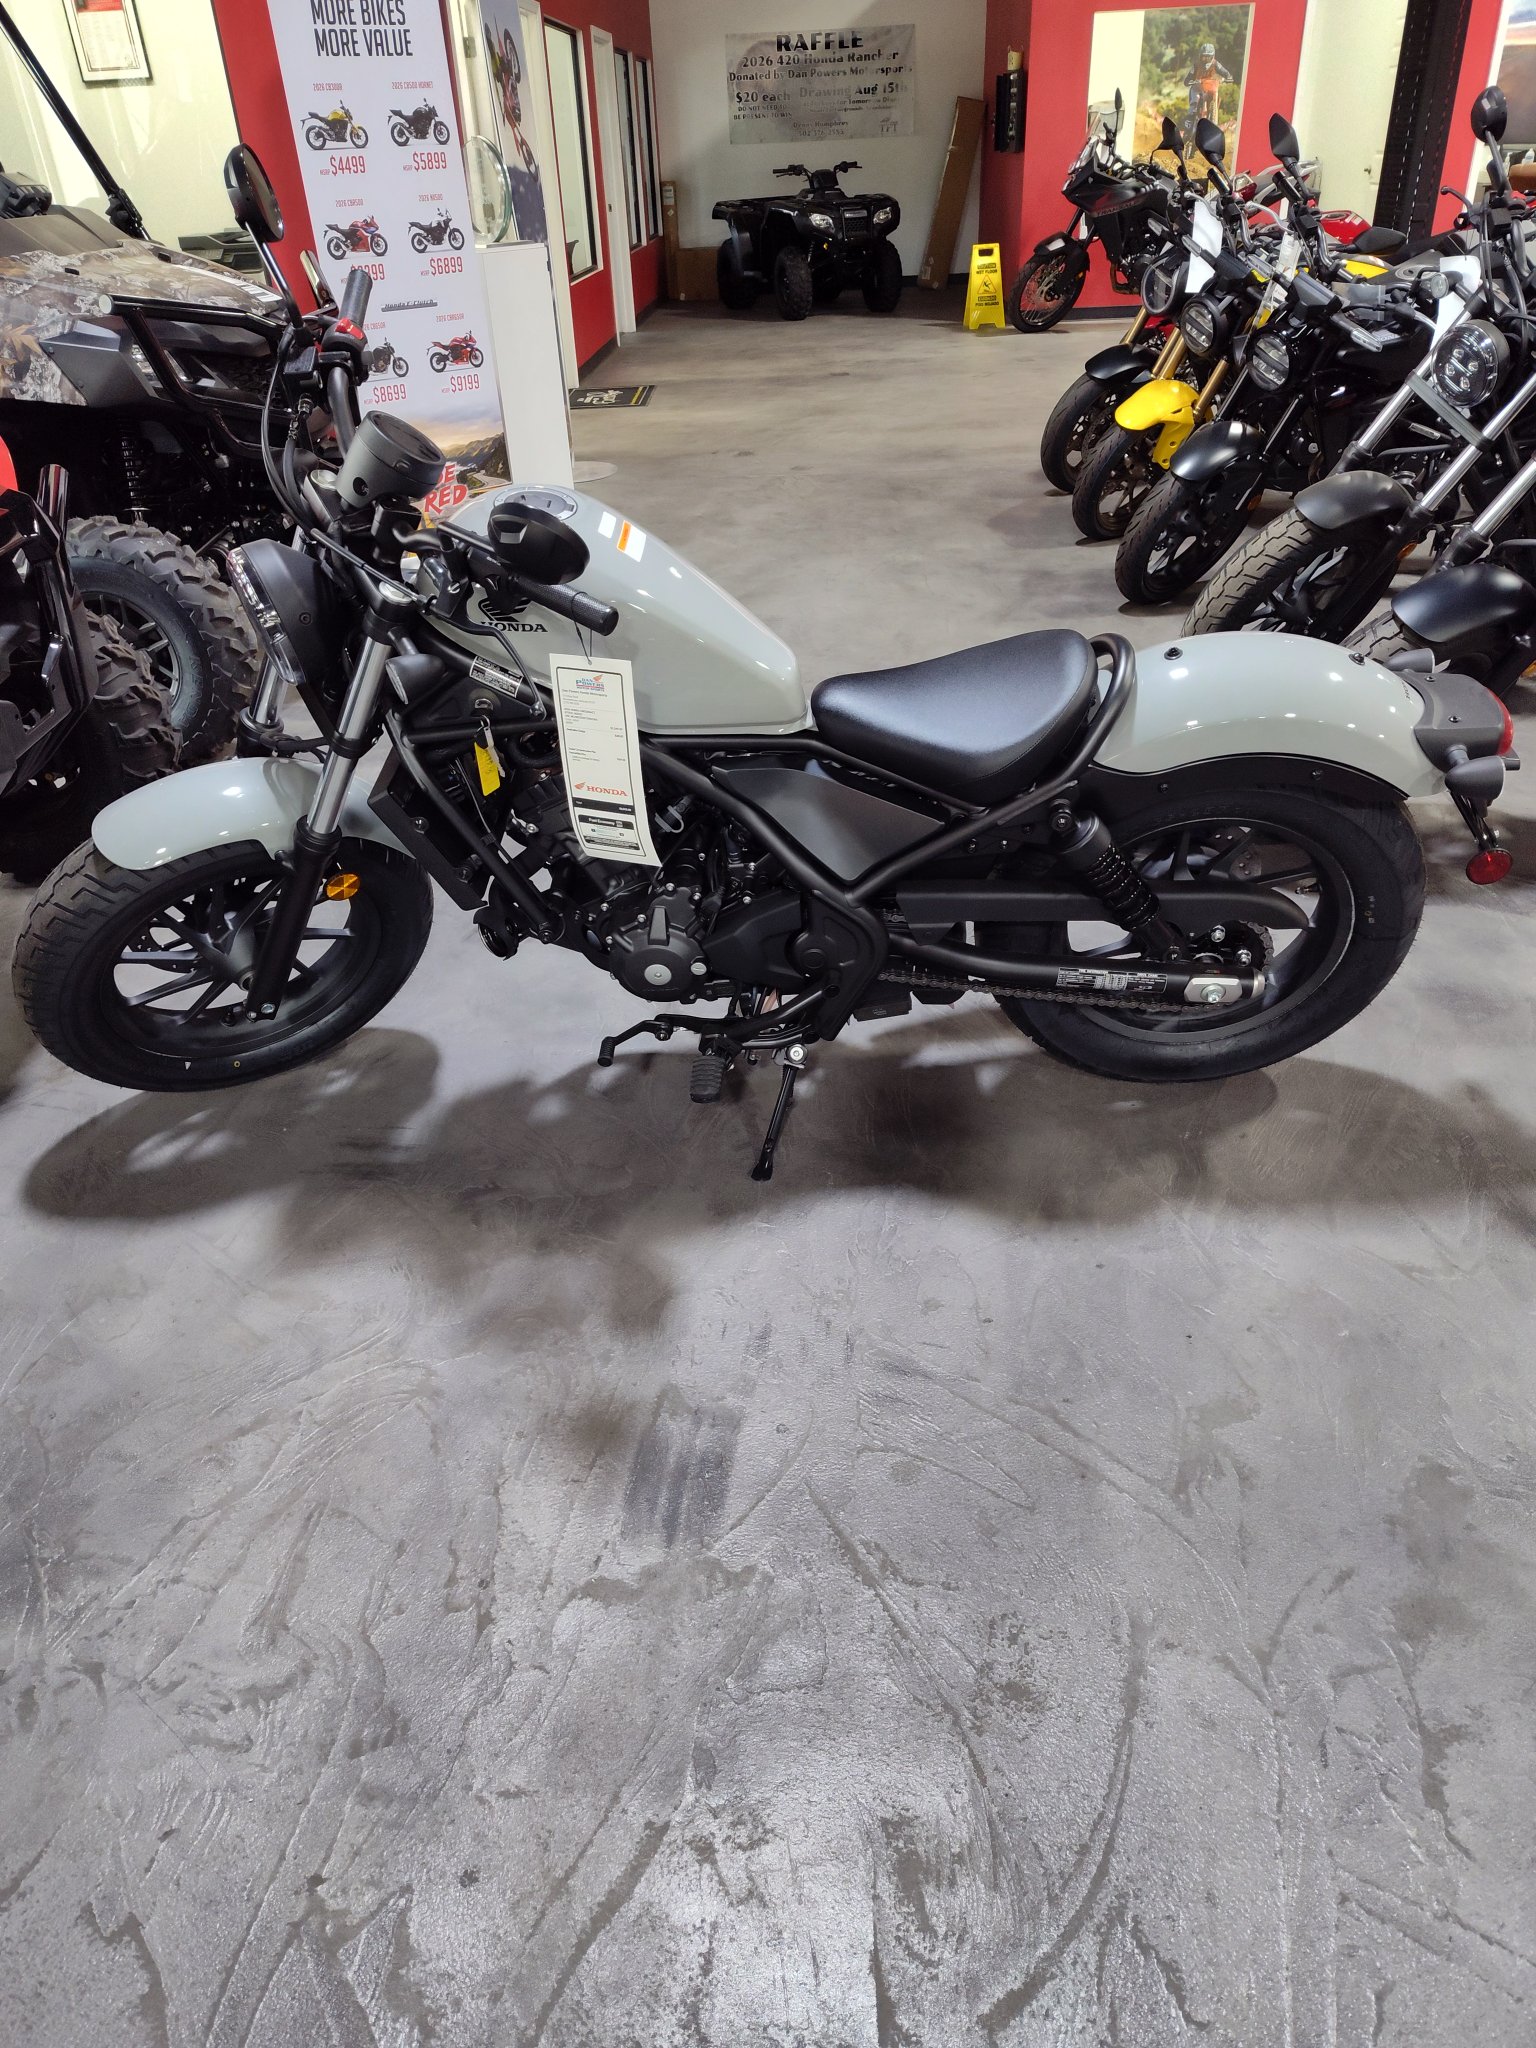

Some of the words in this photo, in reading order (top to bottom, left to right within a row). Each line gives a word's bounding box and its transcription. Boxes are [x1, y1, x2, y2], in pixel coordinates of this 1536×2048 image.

[310, 0, 356, 25] MORE
[360, 0, 406, 25] BIKES
[314, 28, 360, 57] MORE
[362, 28, 413, 57] VALUE
[776, 31, 864, 52] RAFFLE
[742, 56, 773, 68] 2026
[777, 54, 800, 66] 420
[804, 52, 844, 65] Honda
[729, 71, 771, 82] Donated
[773, 71, 785, 81] by
[788, 69, 808, 79] Dan
[810, 67, 847, 78] Powers
[313, 83, 325, 92] 2026
[392, 81, 403, 90] 2026
[736, 91, 759, 105] $20
[762, 91, 790, 102] each
[800, 86, 850, 100] Drawing
[855, 83, 879, 96] Aug
[330, 155, 366, 176] $4499
[412, 151, 447, 173] $5899
[335, 199, 347, 208] 2026
[419, 194, 429, 202] 2026
[429, 256, 463, 277] $6899
[436, 314, 447, 323] 2026
[373, 383, 407, 405] $8699
[450, 373, 480, 394] $9199
[424, 484, 468, 515] RED
[481, 621, 548, 633] ONDA
[586, 785, 628, 797] HONDA
